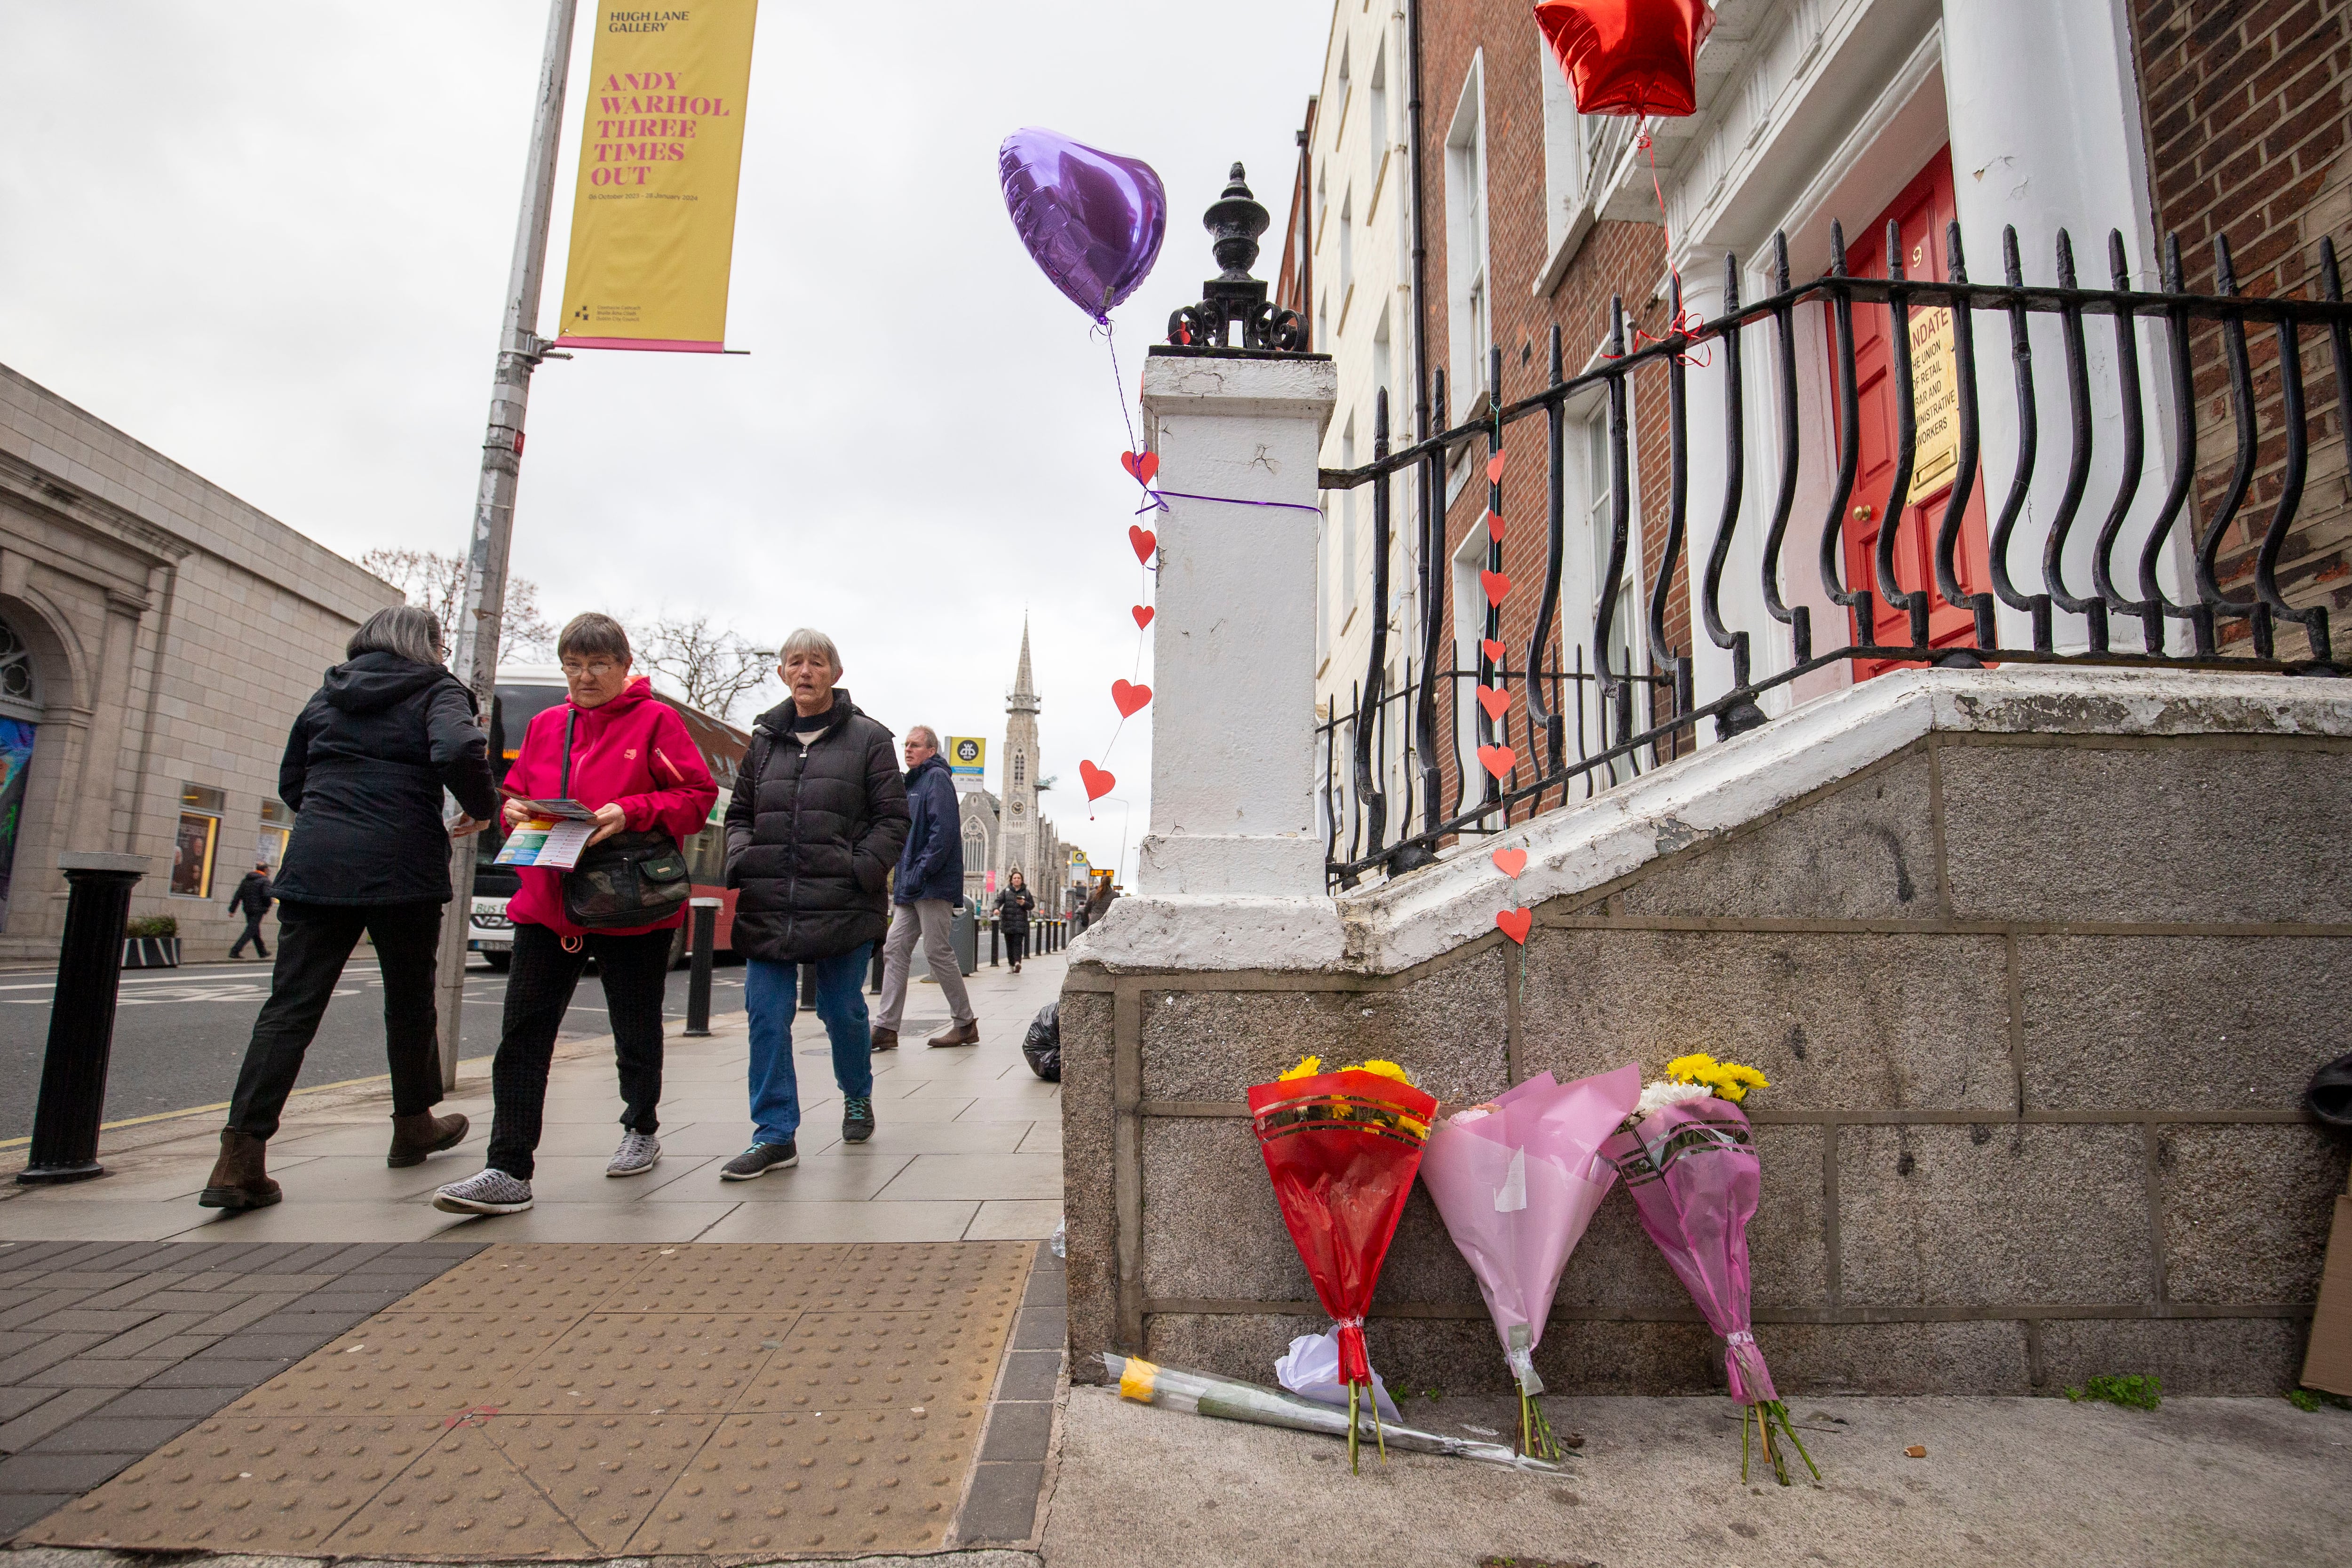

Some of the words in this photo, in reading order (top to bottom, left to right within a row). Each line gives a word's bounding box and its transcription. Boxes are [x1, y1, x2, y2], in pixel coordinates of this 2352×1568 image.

[611, 12, 651, 22] HUGH
[654, 11, 690, 21] LANE
[609, 22, 667, 33] GALLERY
[601, 72, 682, 92] ANDY
[600, 95, 730, 116] WARHOL
[597, 119, 697, 138] THREE
[594, 142, 684, 162] TIMES
[591, 166, 651, 186] OUT
[1913, 246, 1922, 268] 9
[1910, 308, 1948, 353] NDATE
[1922, 339, 1941, 365] UNION
[1921, 360, 1942, 385] RETAIL
[1915, 394, 1928, 410] BAR
[1929, 380, 1941, 399] AND
[1916, 416, 1947, 448] WORKERS
